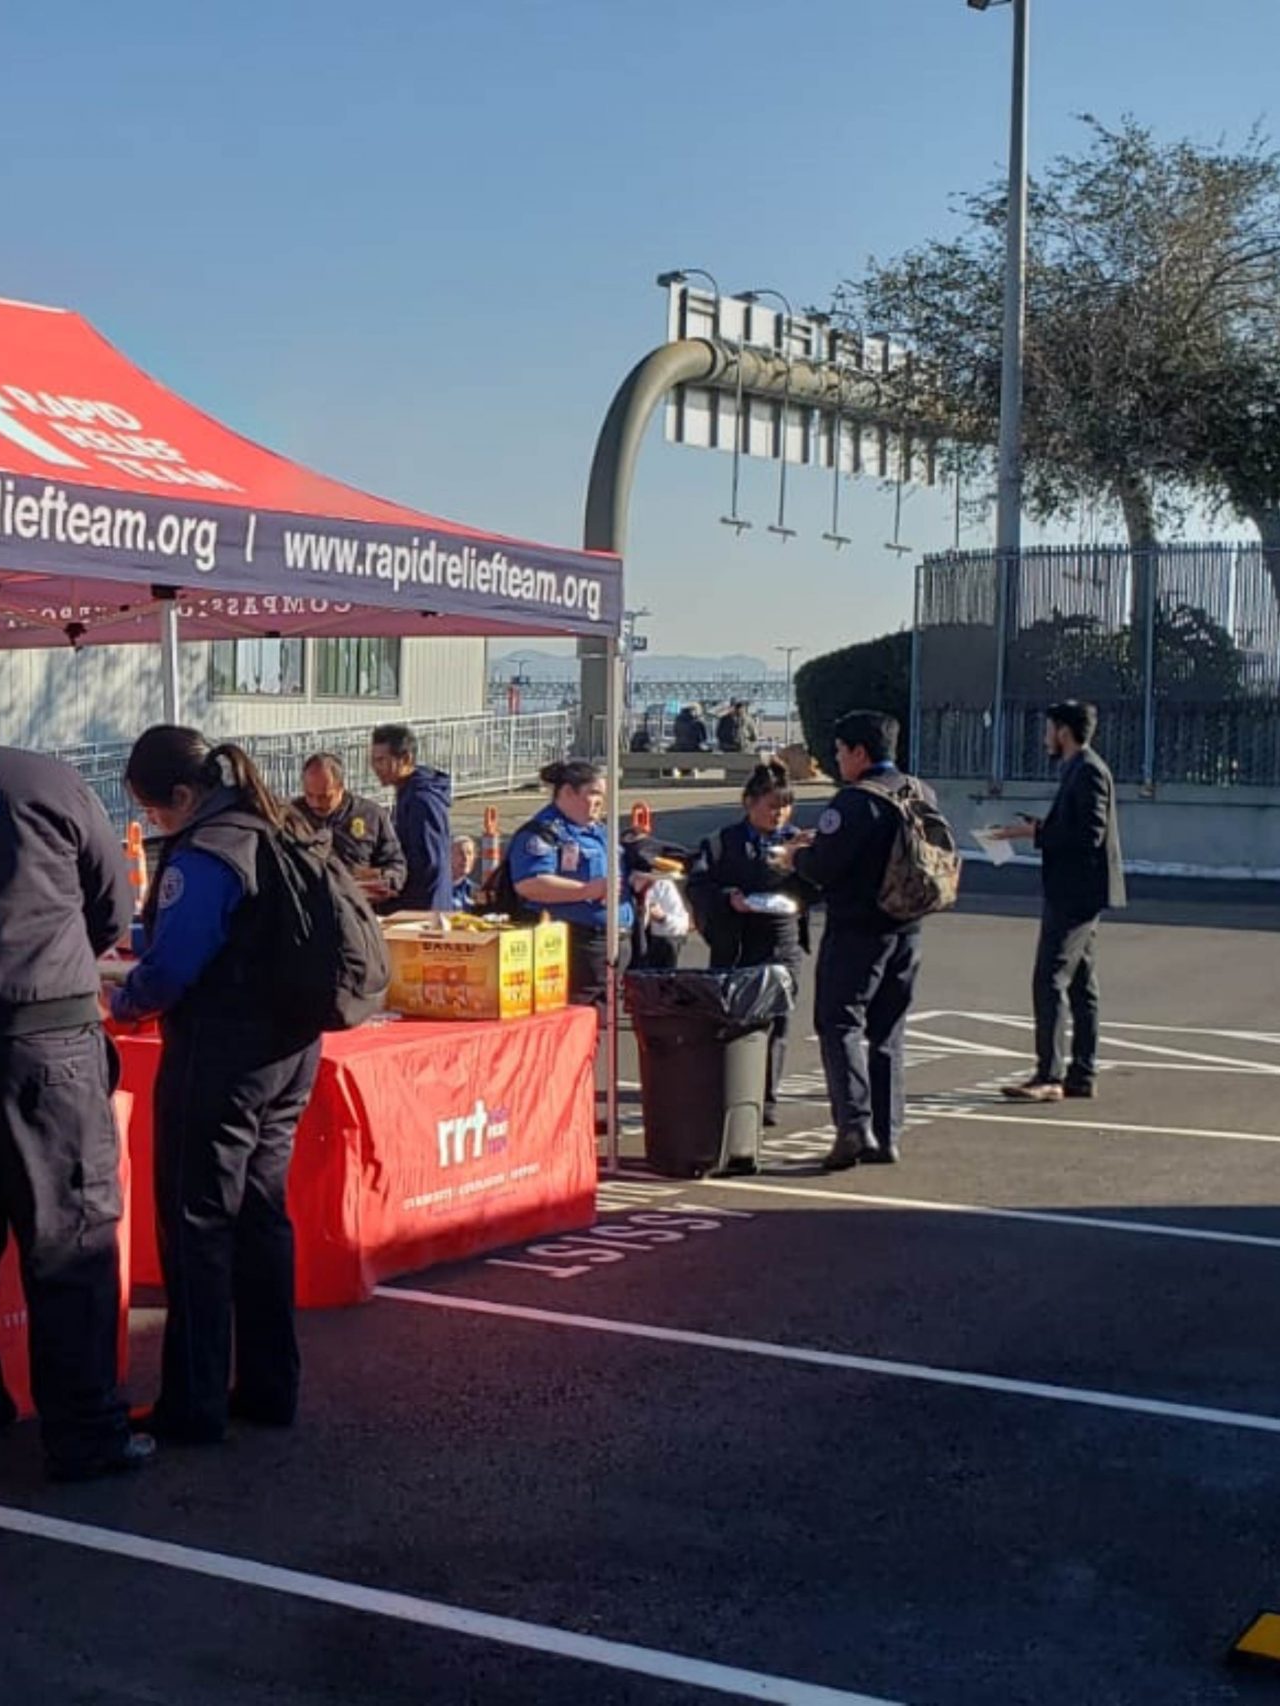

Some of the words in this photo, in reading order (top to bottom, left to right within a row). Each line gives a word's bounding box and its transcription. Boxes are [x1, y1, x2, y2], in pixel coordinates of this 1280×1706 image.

[1, 384, 142, 431] RAPID
[284, 531, 601, 621] www.rapidreliefteam.org
[437, 1097, 488, 1168] rrt
